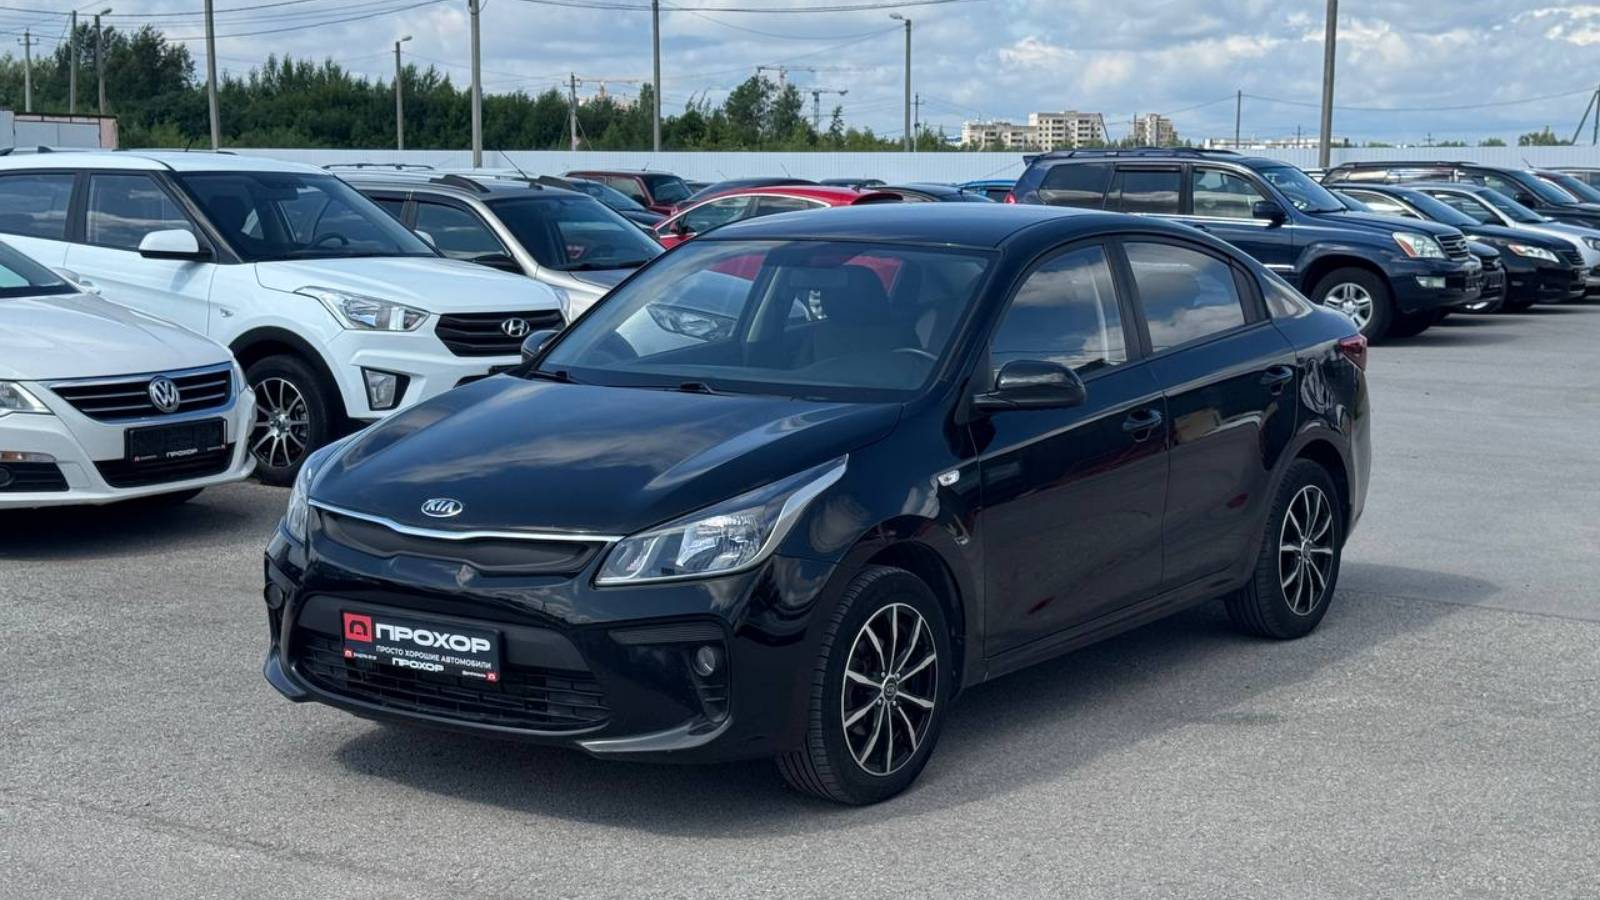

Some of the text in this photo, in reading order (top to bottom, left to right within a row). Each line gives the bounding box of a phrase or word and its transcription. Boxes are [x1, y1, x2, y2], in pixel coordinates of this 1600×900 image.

[375, 623, 491, 653] ПРОХОР
[376, 645, 404, 656] ПРОСТО
[404, 648, 440, 661] ХОРОШИЕ
[441, 655, 492, 669] АВТОМОБИЛИ
[392, 657, 445, 672] ПРОХОР
